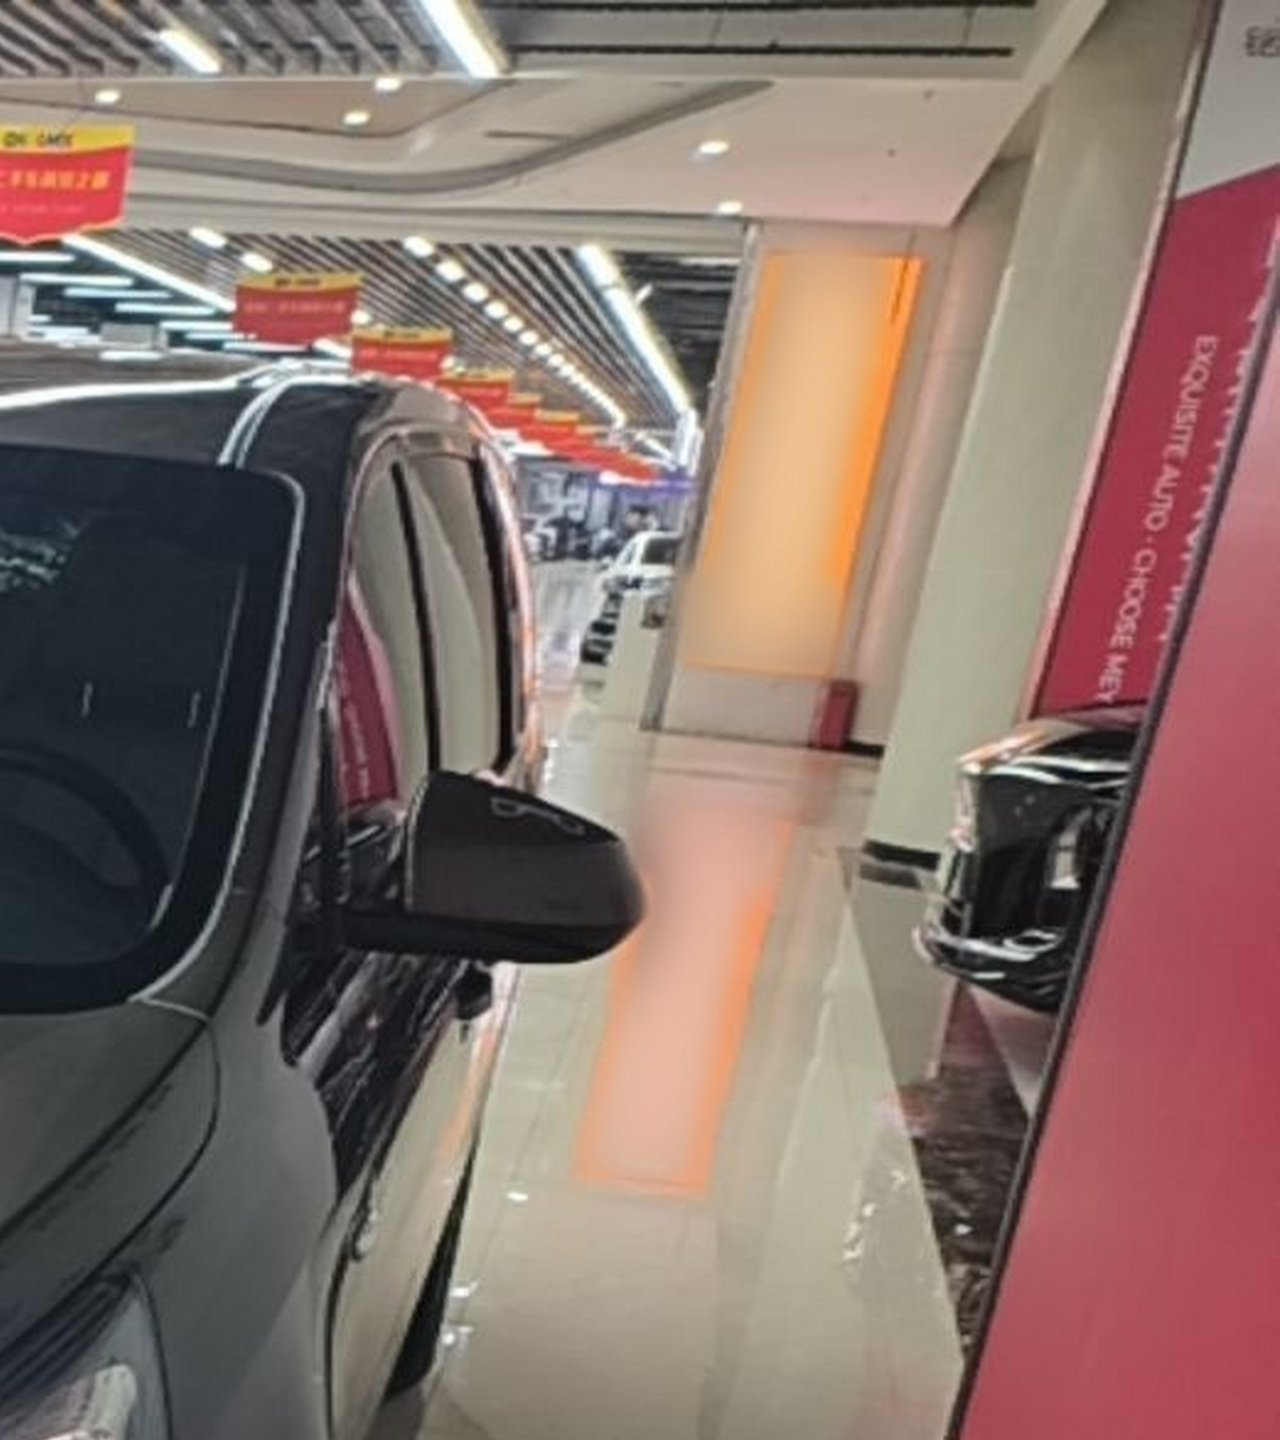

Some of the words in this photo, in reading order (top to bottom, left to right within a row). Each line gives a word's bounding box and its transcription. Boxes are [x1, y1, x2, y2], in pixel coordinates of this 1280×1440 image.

[1163, 334, 1217, 461] EXQUISITE
[1145, 465, 1182, 533] AUTO
[1108, 549, 1158, 650] CHOOSE
